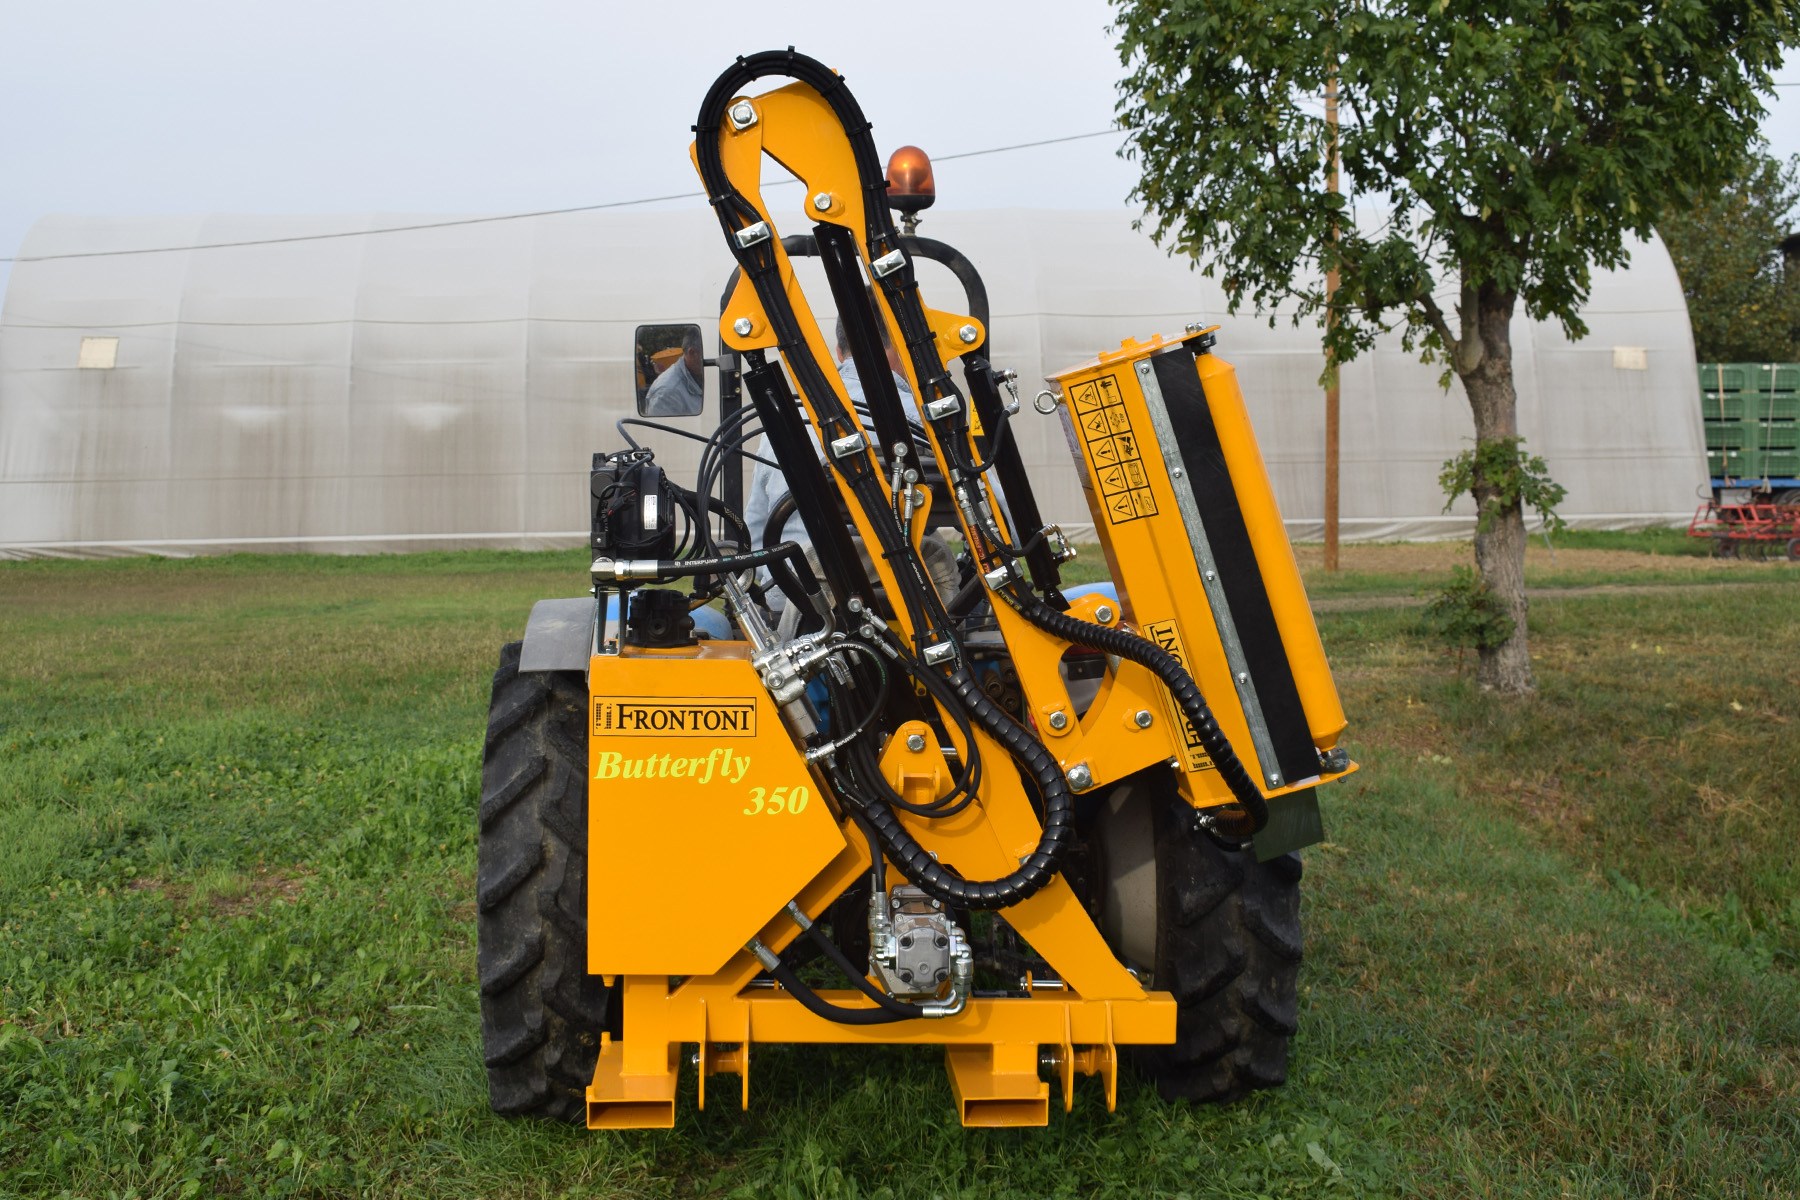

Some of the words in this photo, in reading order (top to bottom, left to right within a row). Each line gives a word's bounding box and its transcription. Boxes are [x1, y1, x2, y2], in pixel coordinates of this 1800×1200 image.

[615, 703, 755, 731] FRONTONI
[593, 748, 751, 784] Butterfly
[743, 786, 809, 815] 350
